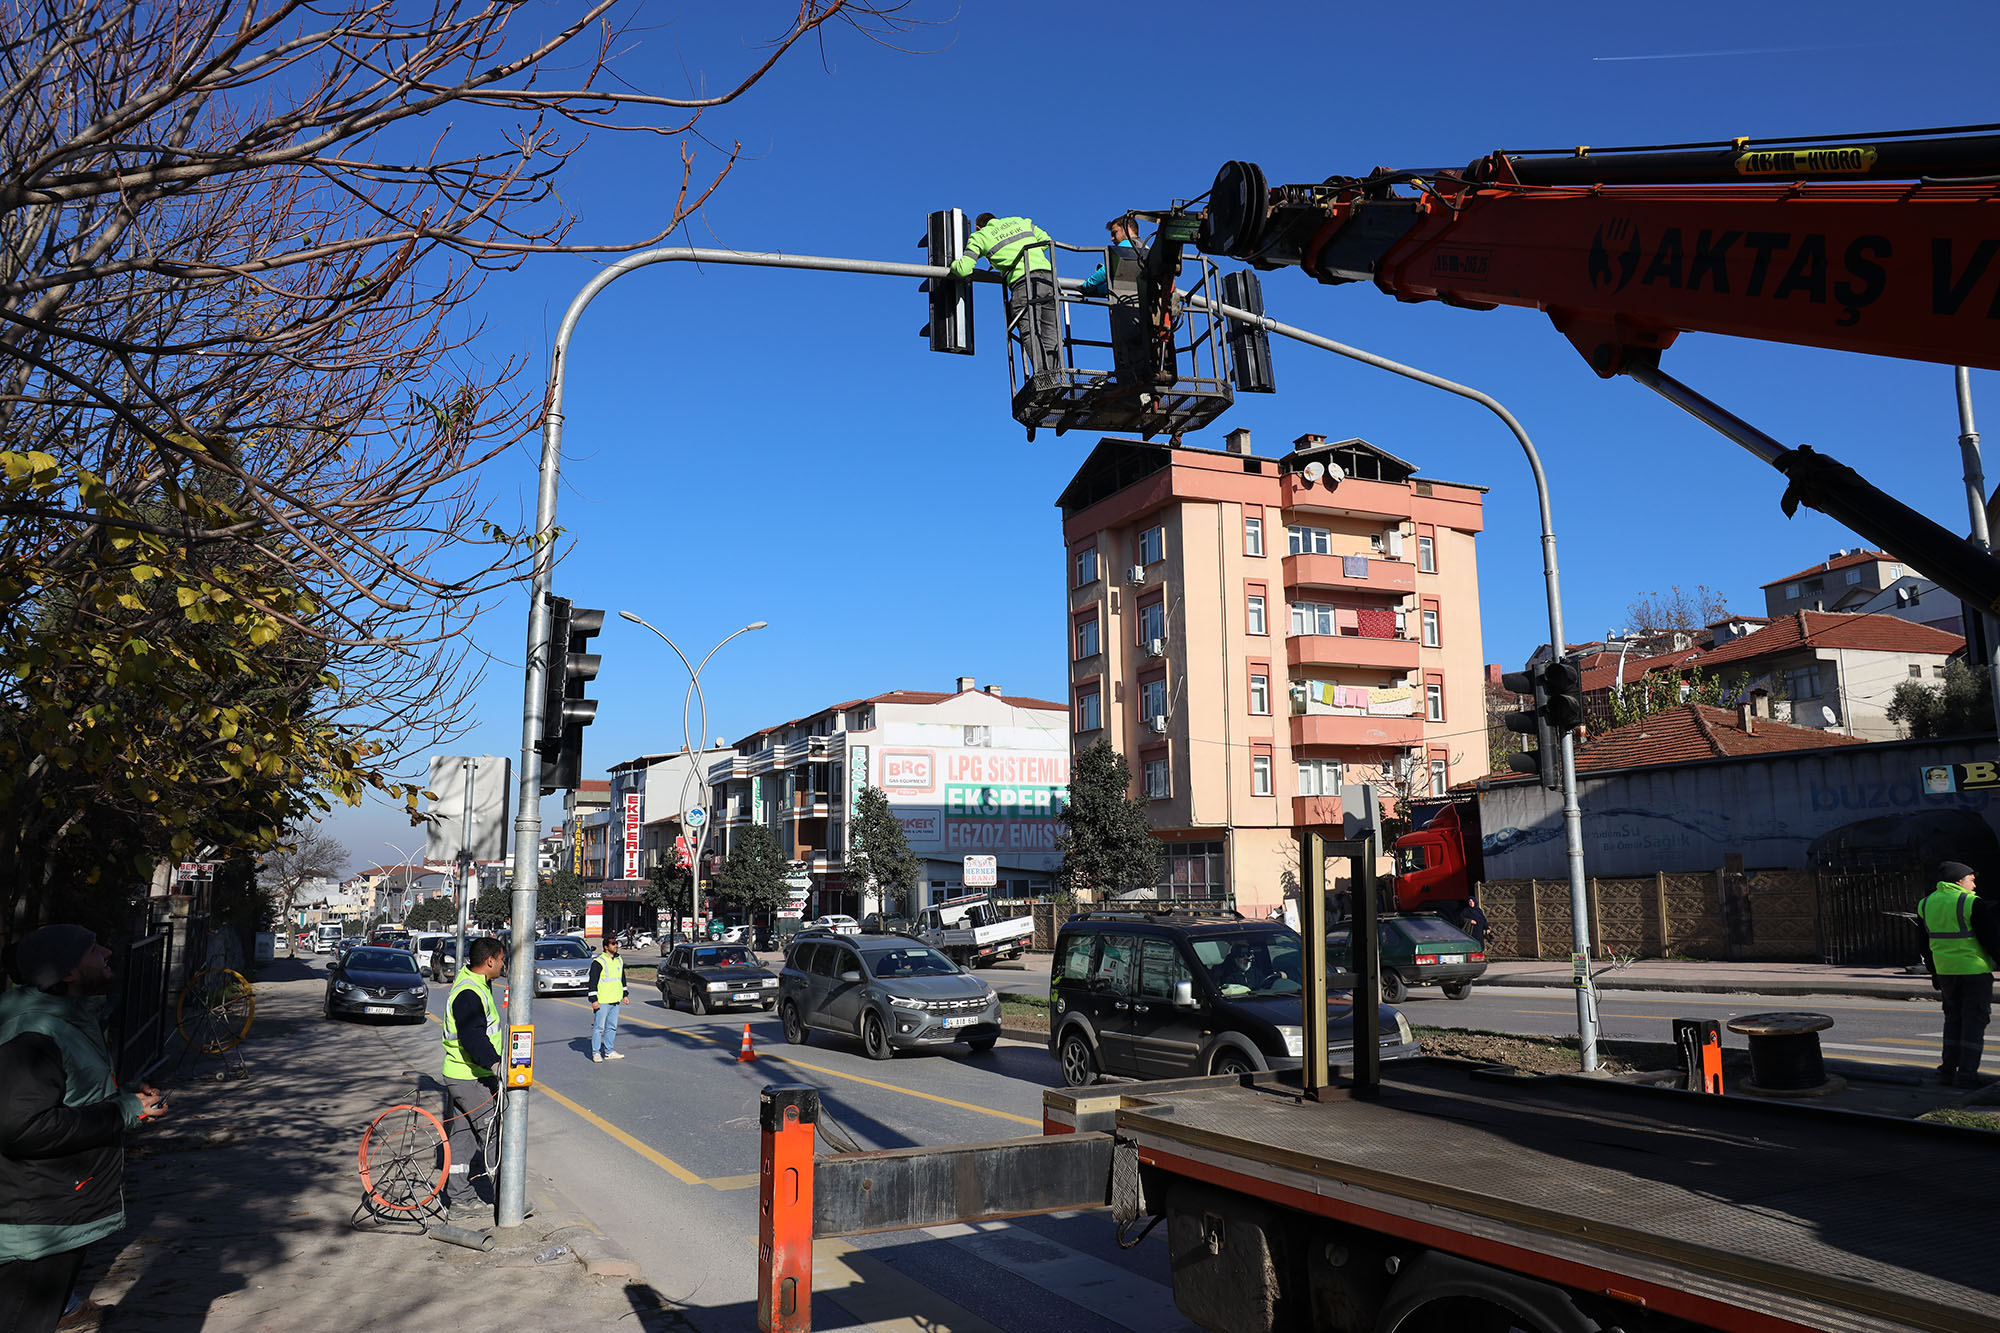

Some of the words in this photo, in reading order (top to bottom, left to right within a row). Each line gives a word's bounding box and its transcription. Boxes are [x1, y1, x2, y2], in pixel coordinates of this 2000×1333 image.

[1745, 150, 1862, 172] ABM-HYDRO
[1641, 227, 1893, 326] AKTAŞ
[1931, 238, 2000, 320] V
[889, 760, 926, 776] BRC
[948, 756, 983, 782] LPG
[1960, 761, 2000, 784] B
[625, 795, 639, 878] EKSPERTİZ
[949, 823, 1007, 849] EGZOZ
